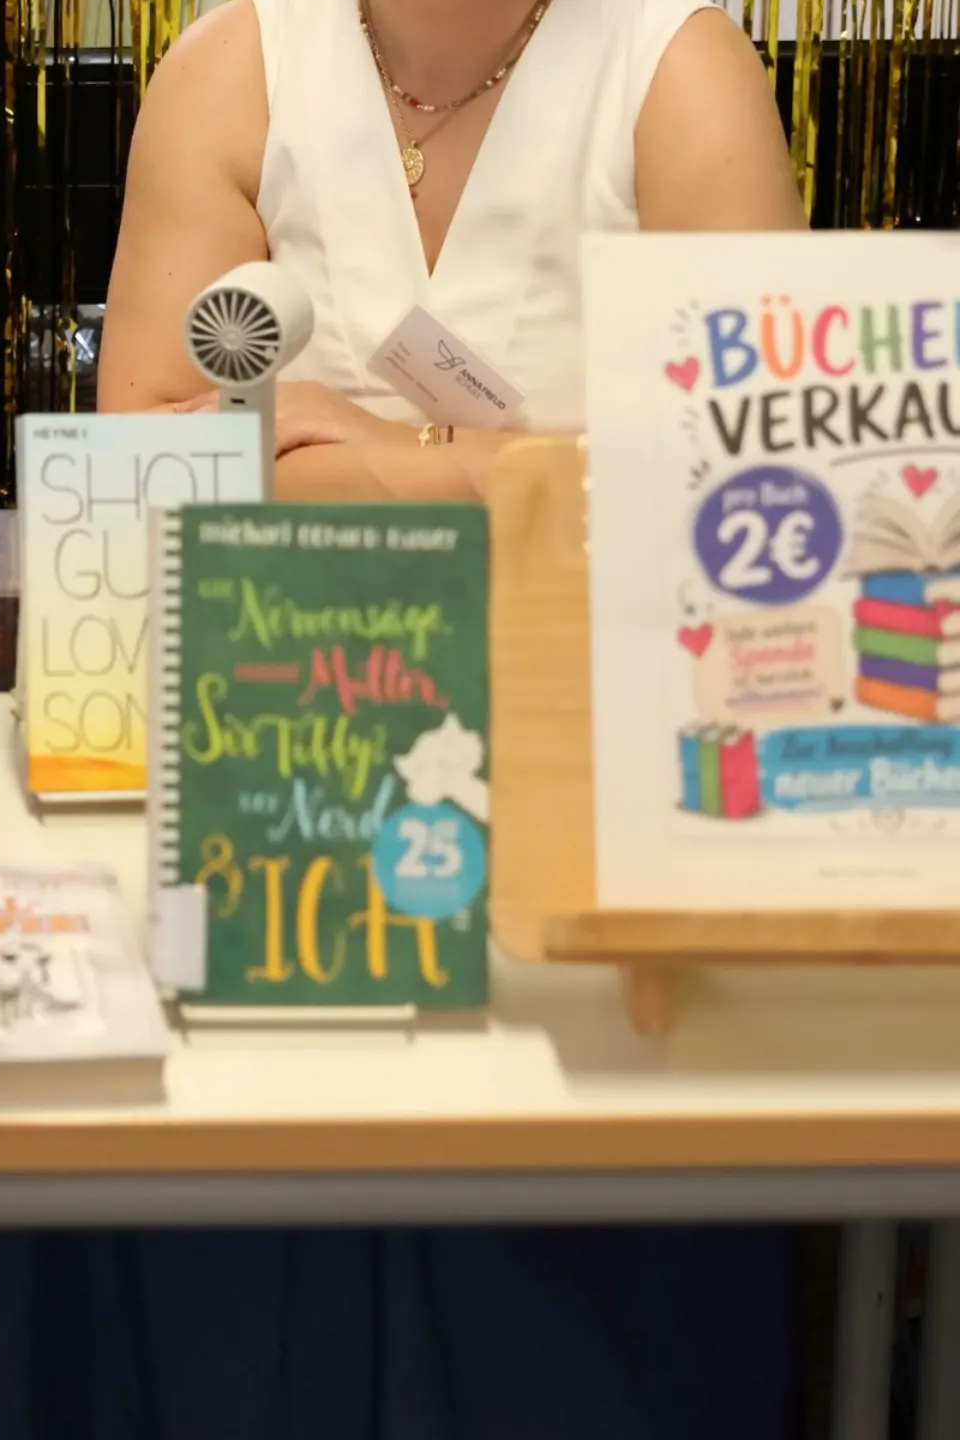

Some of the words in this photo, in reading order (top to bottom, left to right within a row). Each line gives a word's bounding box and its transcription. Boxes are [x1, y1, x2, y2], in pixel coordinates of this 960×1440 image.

[705, 294, 960, 388] BÜCHE
[708, 381, 960, 457] VERKAU
[40, 451, 243, 525] SHOT
[55, 529, 150, 600] GU
[717, 509, 821, 589] 2€
[42, 614, 150, 677] LOV
[43, 690, 147, 754] SON
[395, 818, 463, 878] 25
